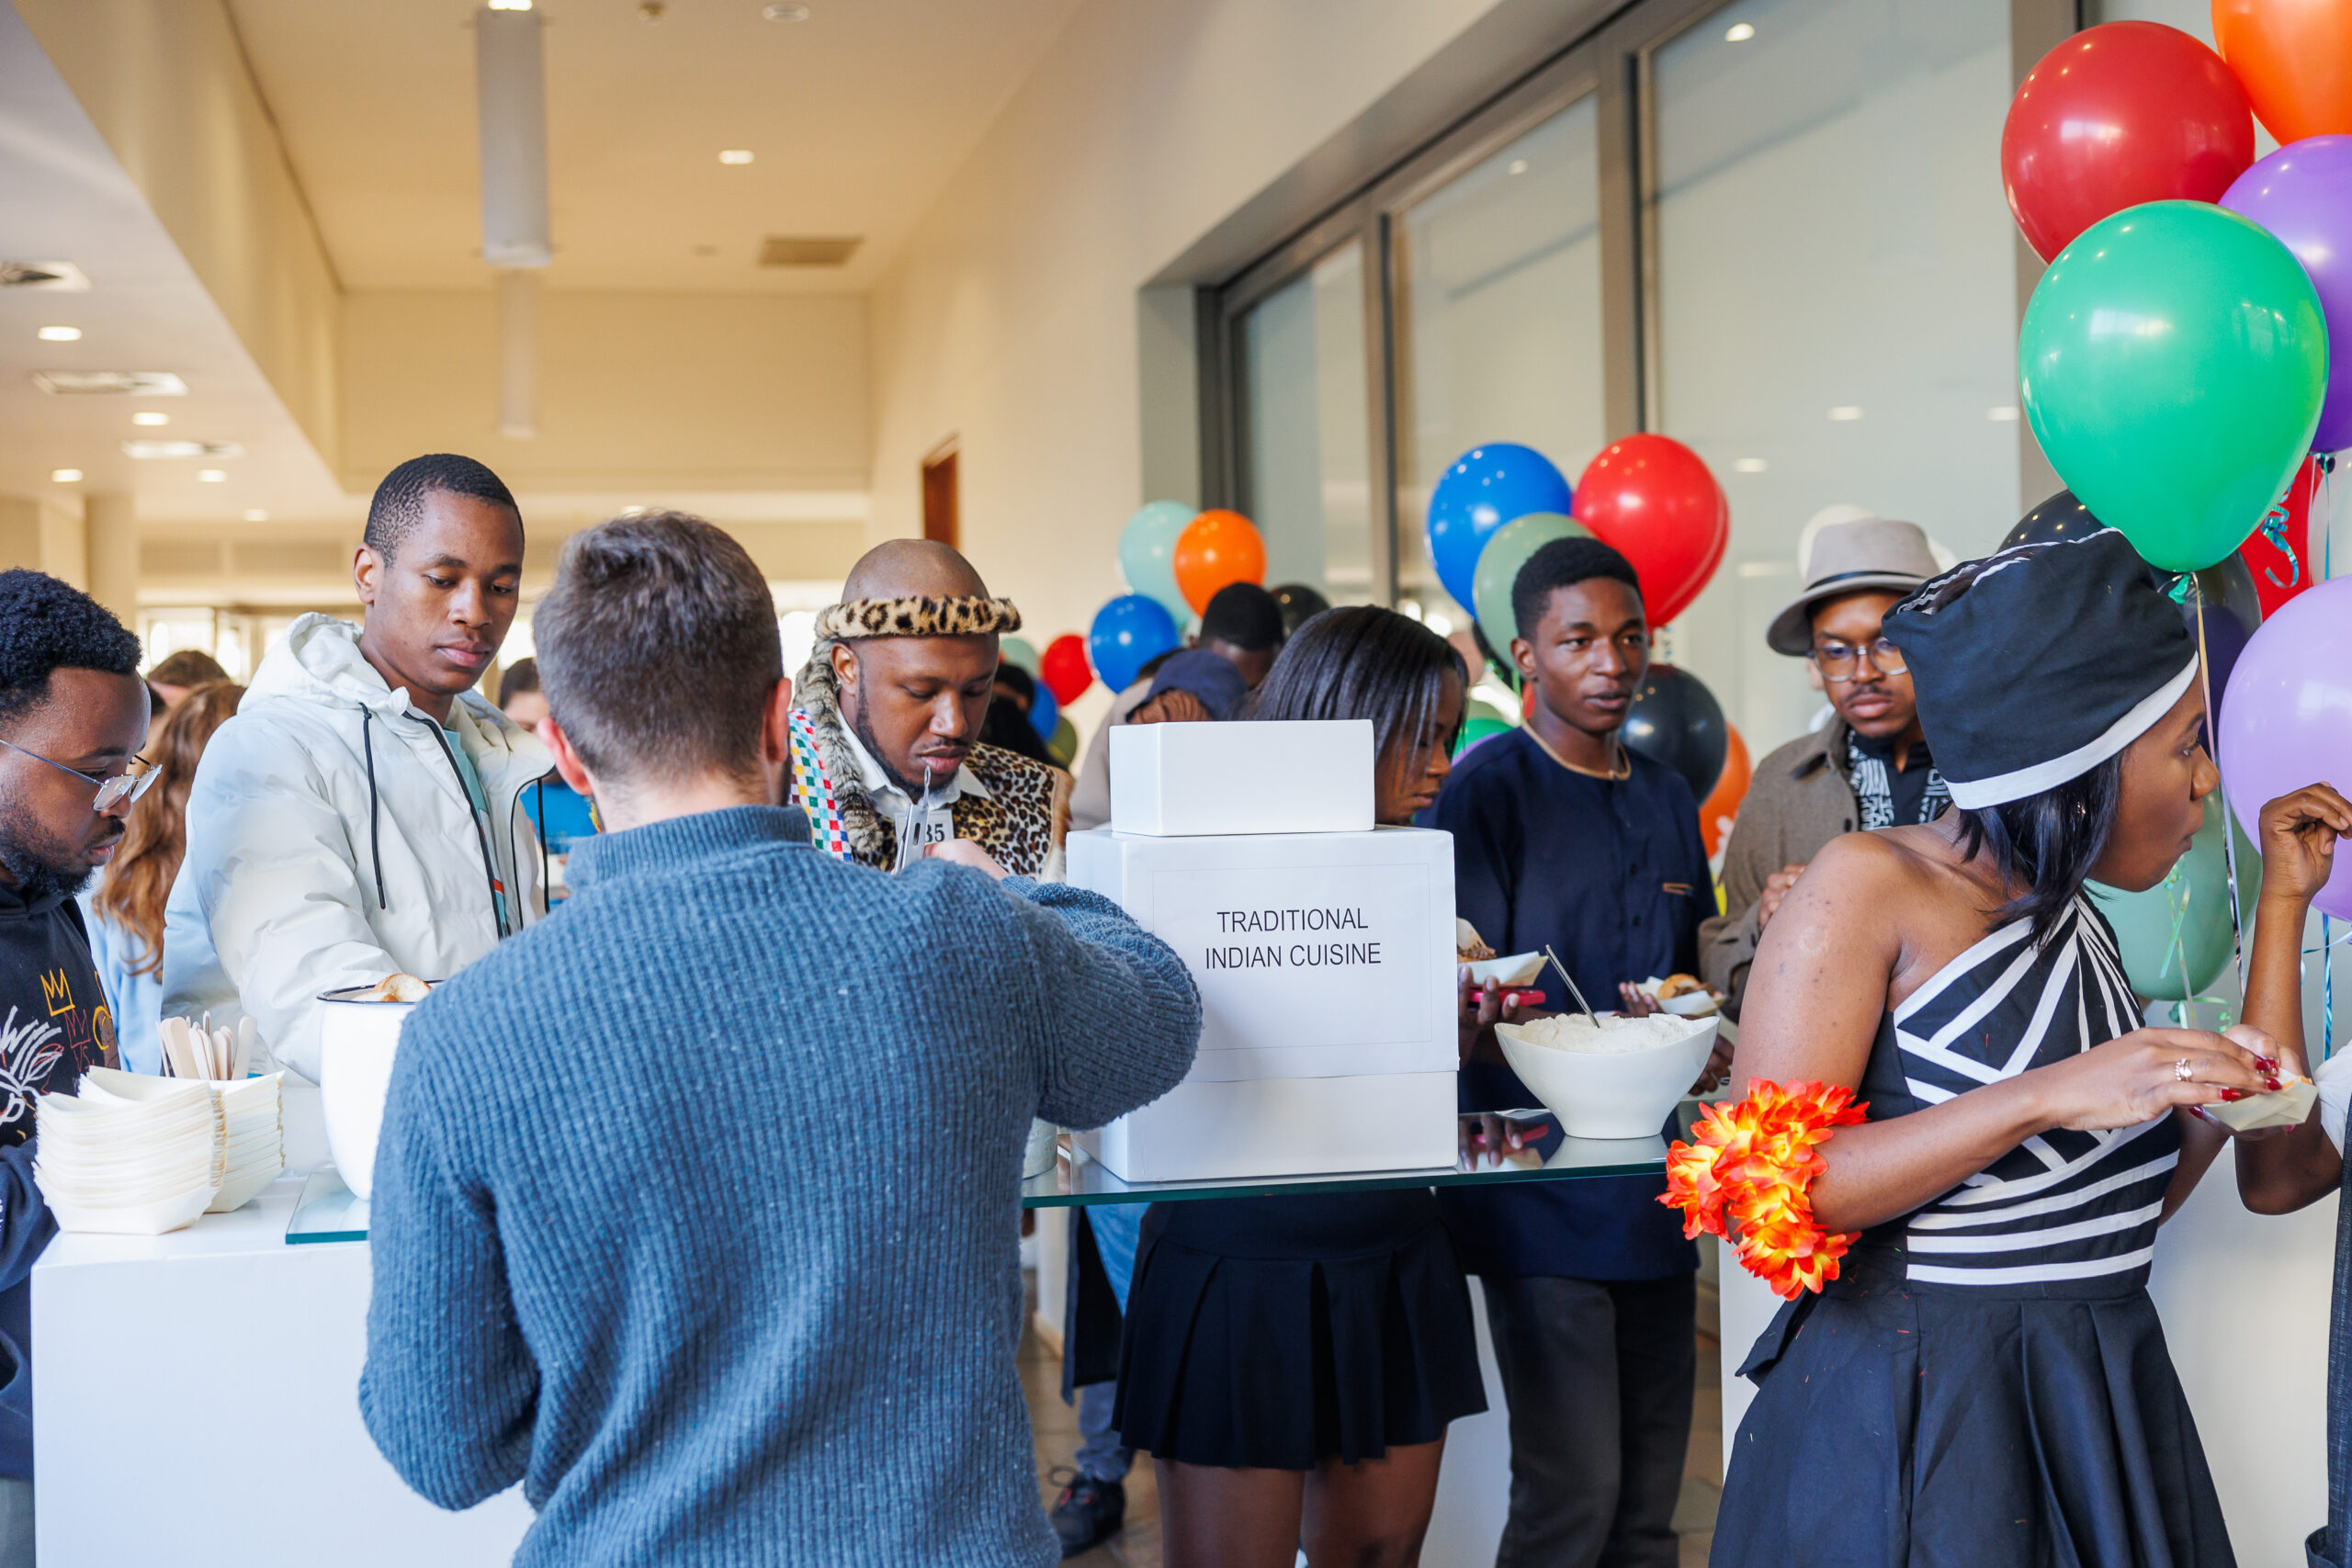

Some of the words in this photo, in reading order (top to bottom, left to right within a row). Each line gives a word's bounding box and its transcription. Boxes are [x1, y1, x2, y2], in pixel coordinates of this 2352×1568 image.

[1216, 908, 1369, 933] TRADITIONAL
[1205, 945, 1282, 970] INDIAN
[1289, 942, 1382, 967] CUISINE
